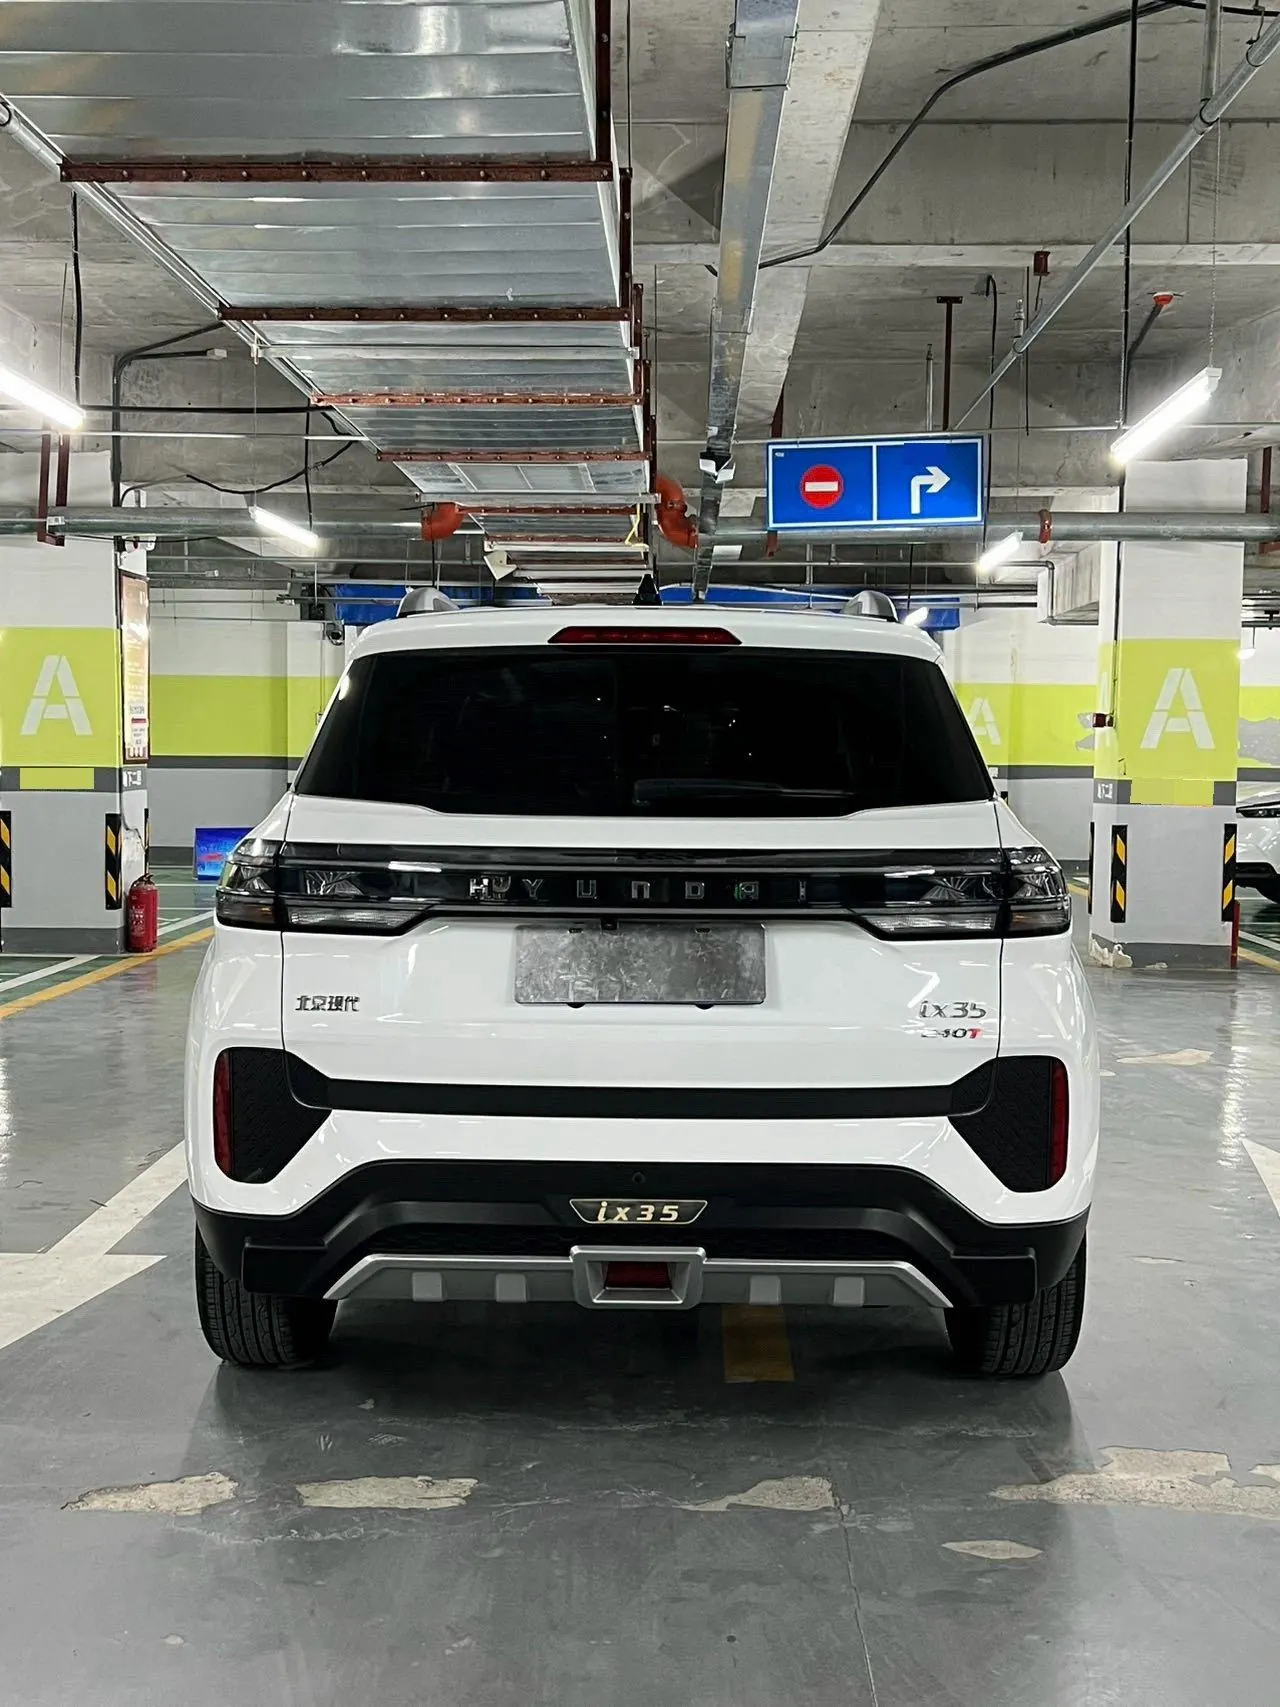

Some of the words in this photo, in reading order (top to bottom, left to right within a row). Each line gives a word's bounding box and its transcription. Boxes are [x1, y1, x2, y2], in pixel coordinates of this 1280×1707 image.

[20, 654, 93, 736] A
[1140, 667, 1216, 749] A
[967, 697, 1001, 745] A
[920, 1000, 987, 1019] ix35
[597, 1200, 679, 1222] ix35
